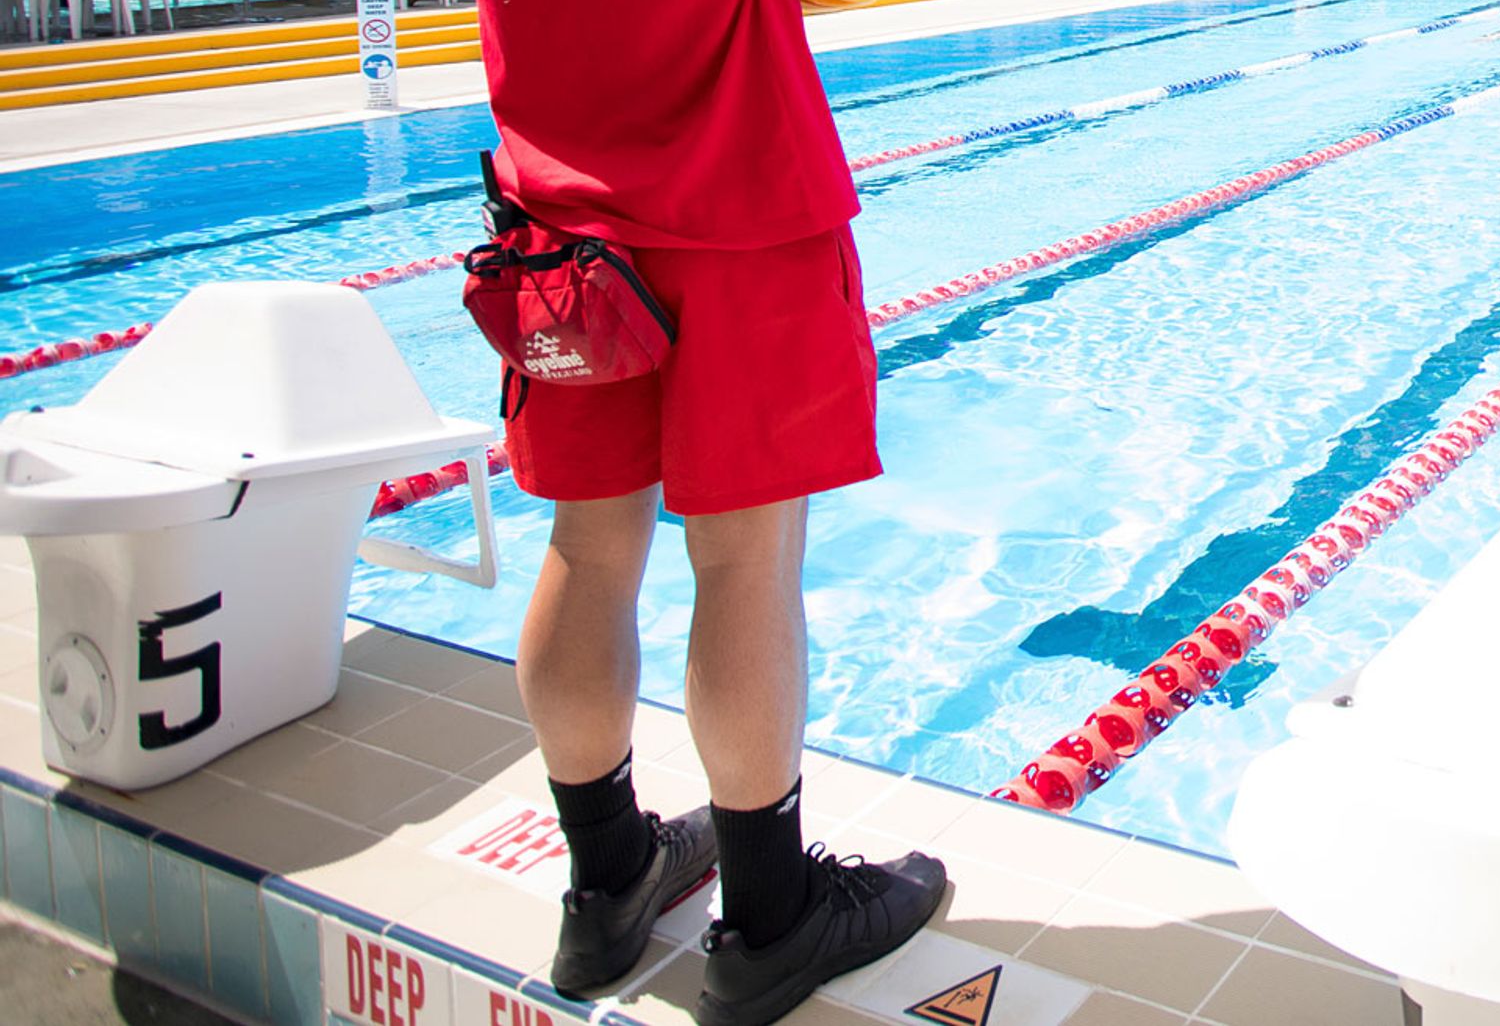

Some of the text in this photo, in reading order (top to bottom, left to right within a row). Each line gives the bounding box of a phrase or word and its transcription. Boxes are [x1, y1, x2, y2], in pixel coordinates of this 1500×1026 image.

[524, 352, 586, 375] eyeline
[138, 590, 222, 751] 5
[457, 808, 571, 875] DEEP
[346, 933, 426, 1026] DEEP
